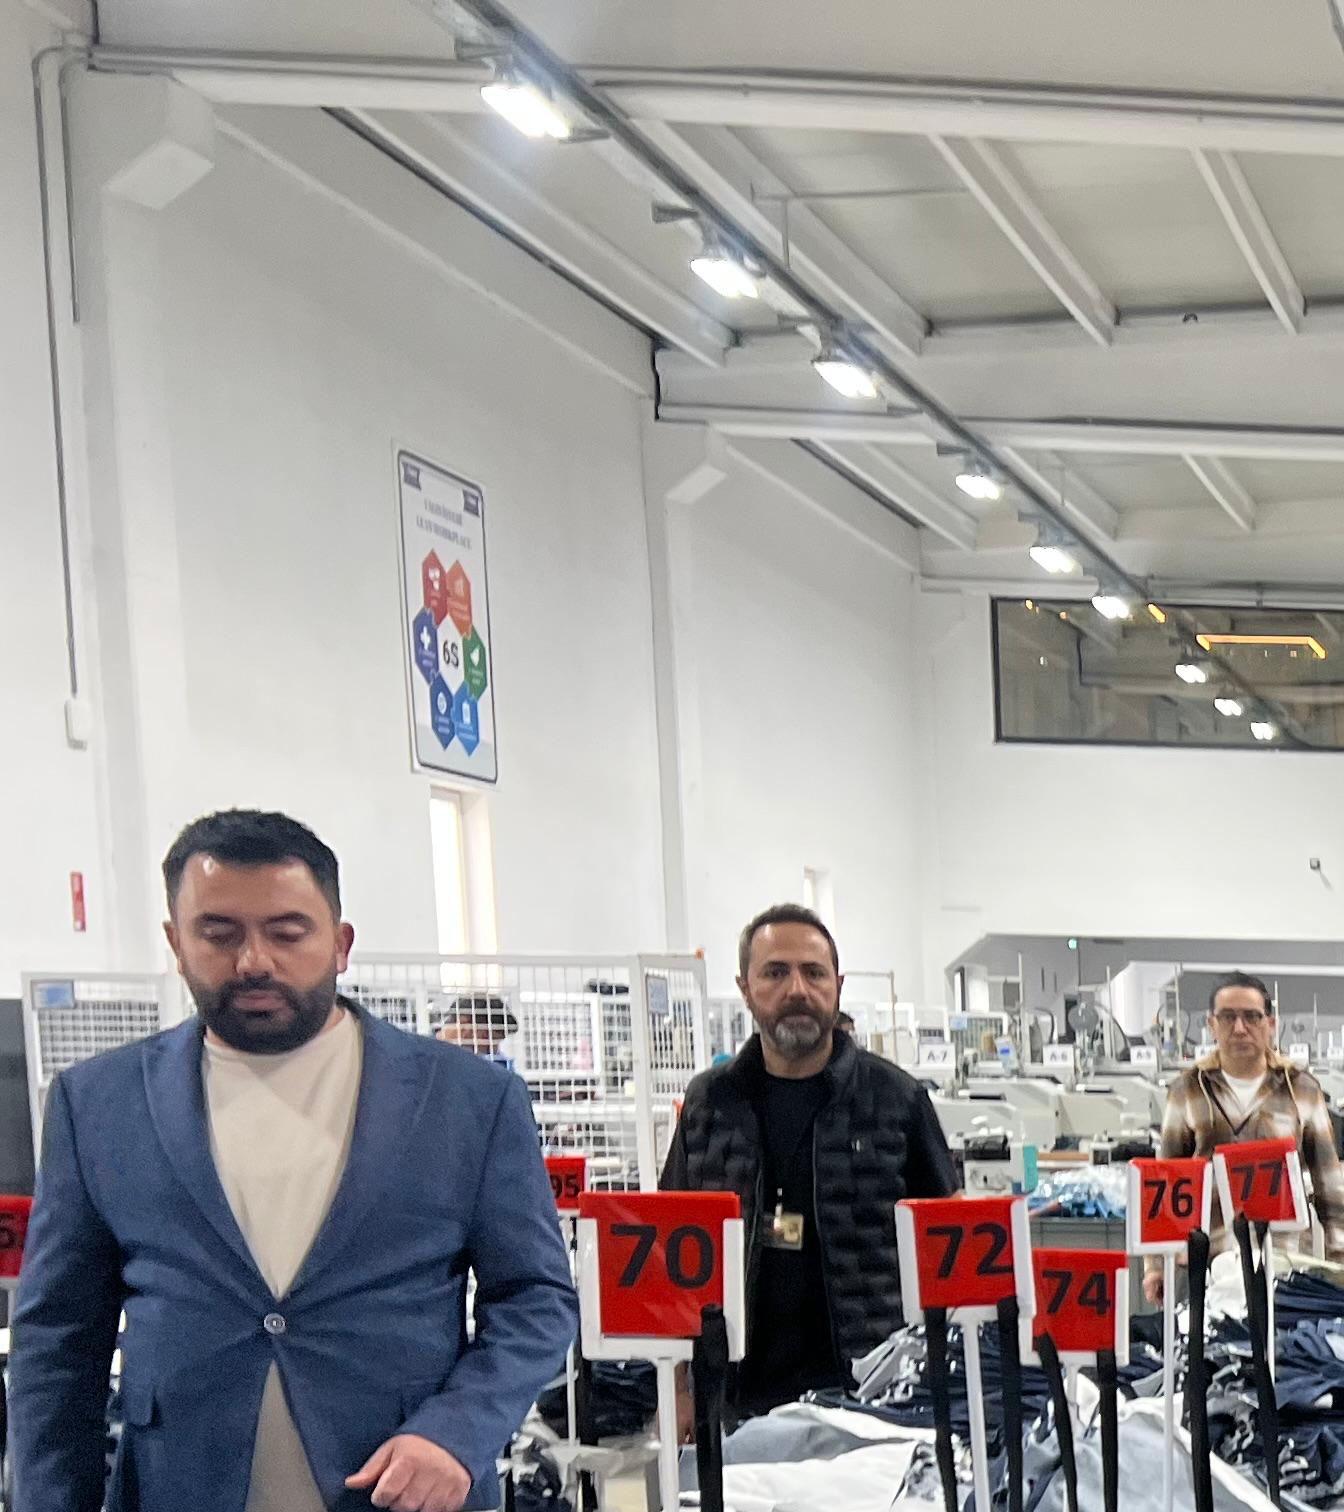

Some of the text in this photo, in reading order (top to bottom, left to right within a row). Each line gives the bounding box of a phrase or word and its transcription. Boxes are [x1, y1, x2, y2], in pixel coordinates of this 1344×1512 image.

[442, 641, 459, 668] 6S
[1144, 1179, 1194, 1220] 76
[1231, 1158, 1286, 1200] 77
[610, 1224, 715, 1288] 70
[925, 1222, 1014, 1277] 72
[1041, 1270, 1111, 1316] 74
